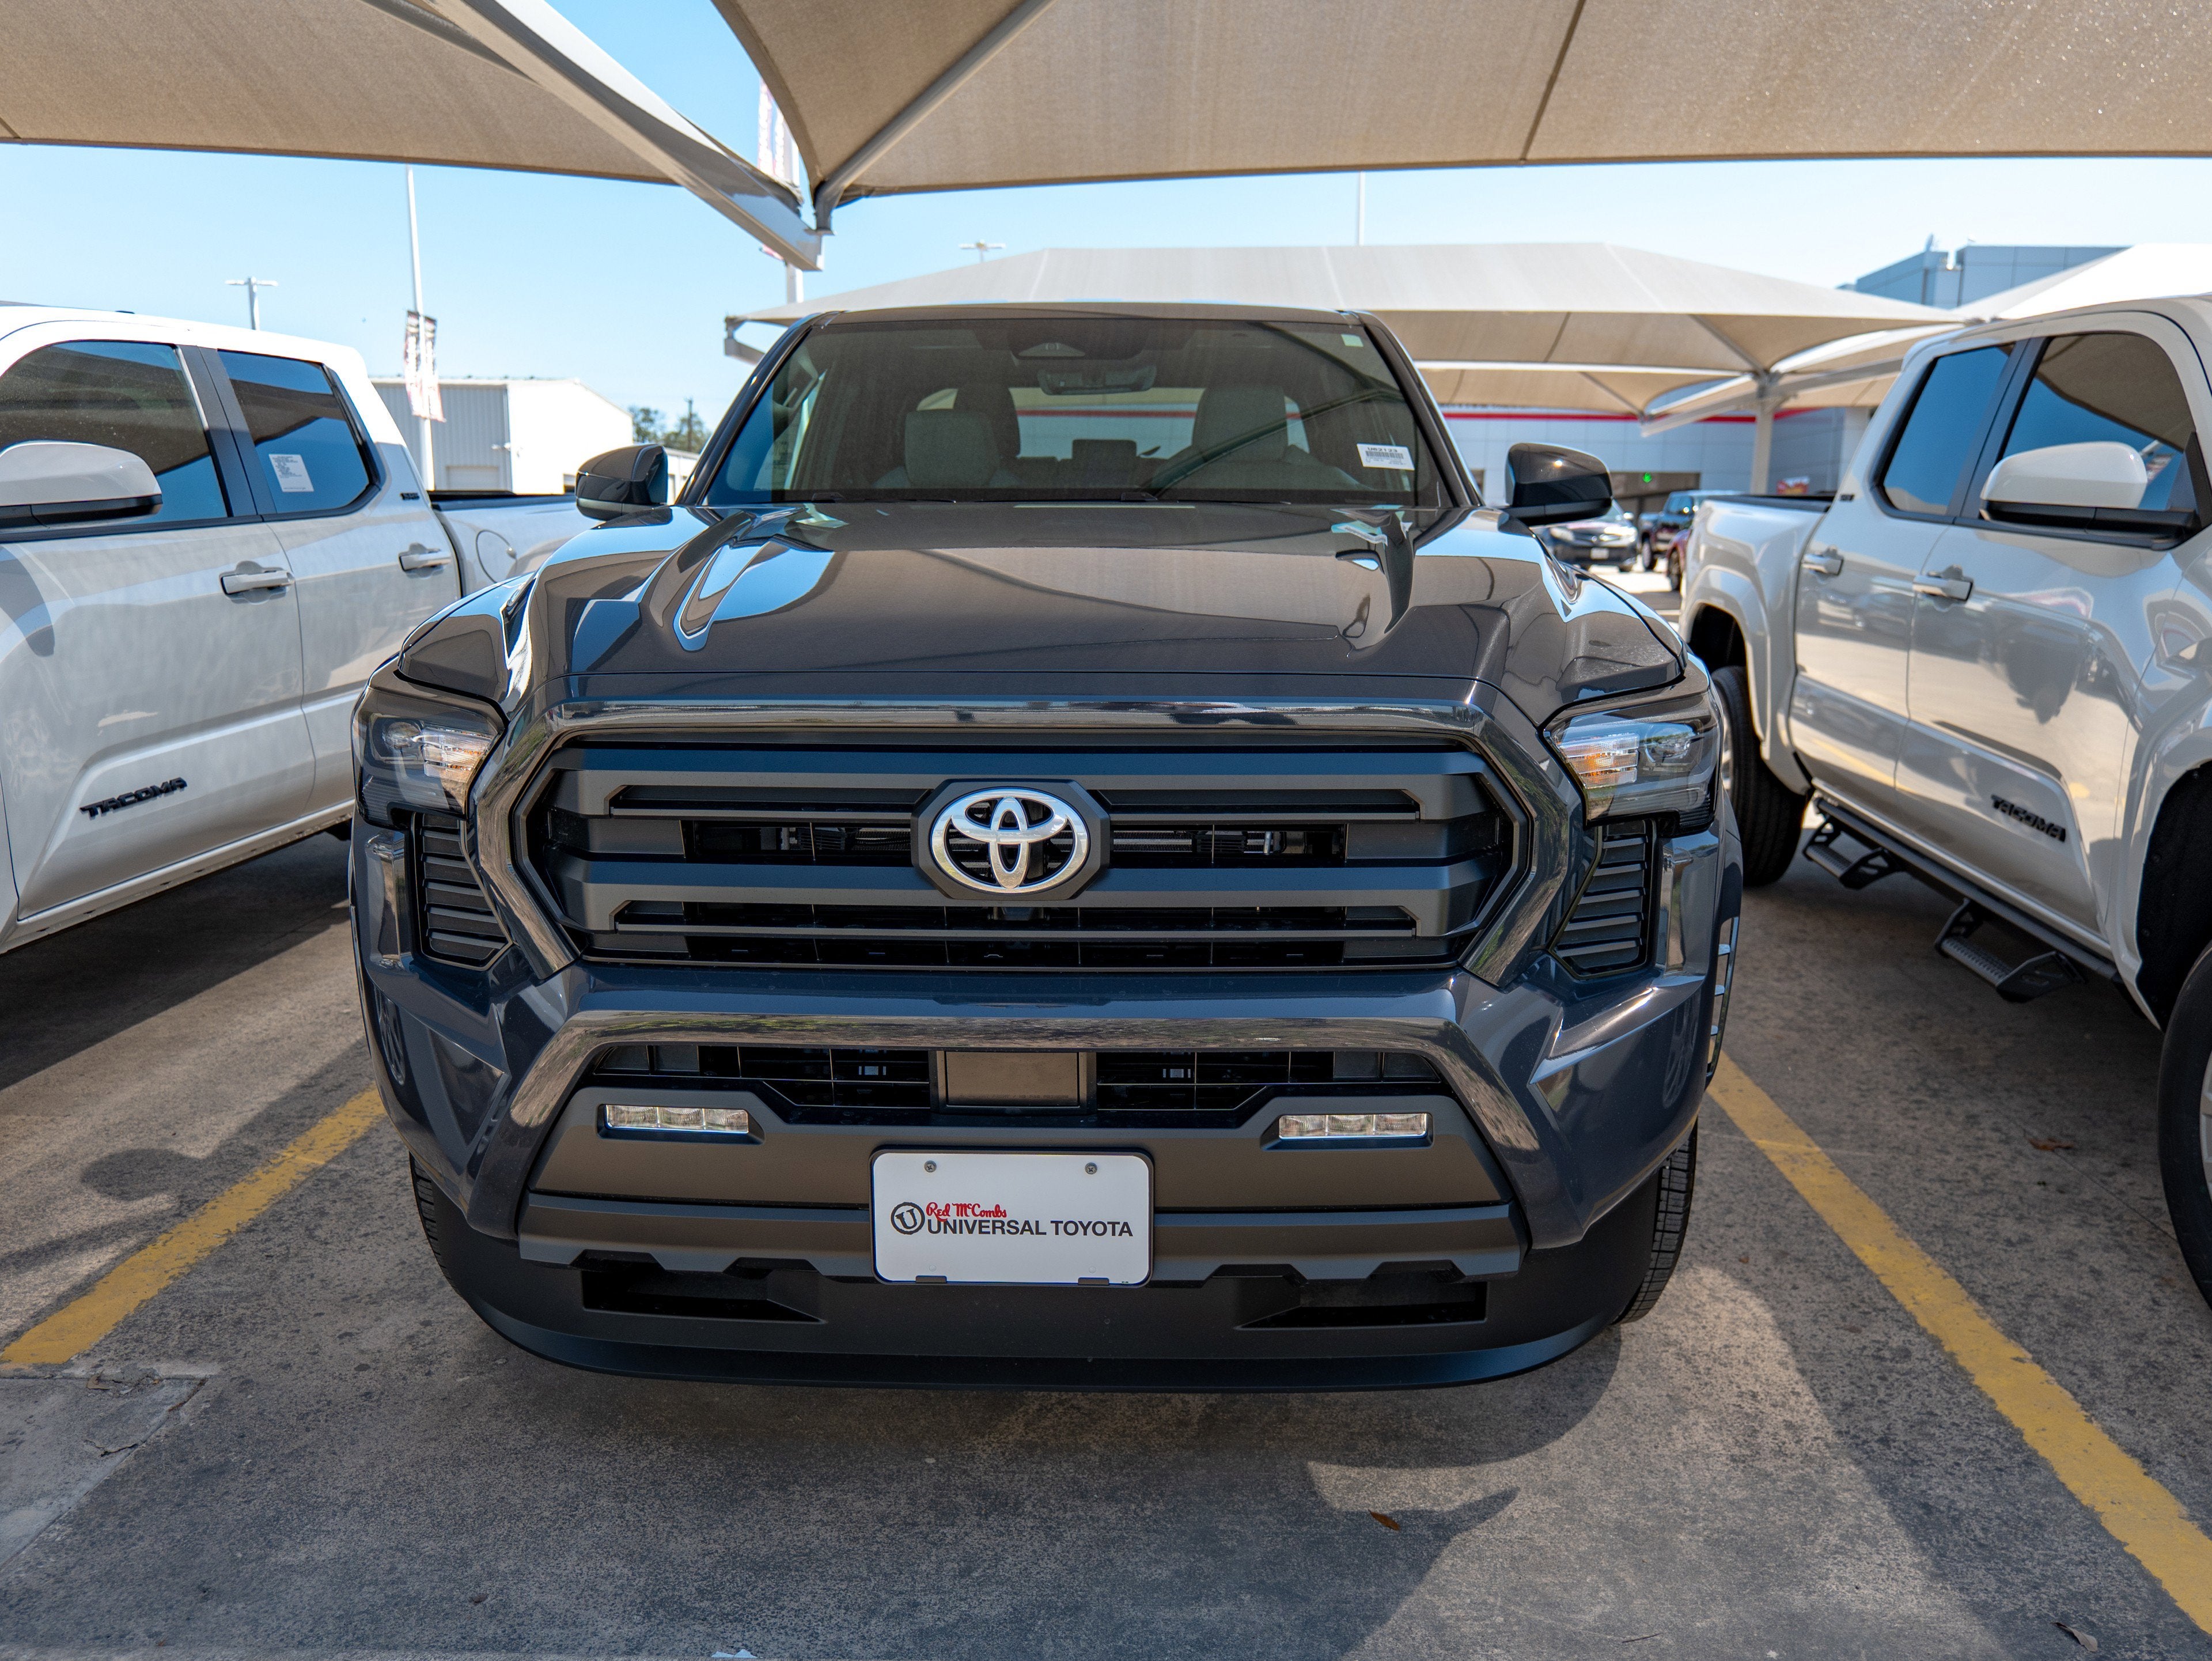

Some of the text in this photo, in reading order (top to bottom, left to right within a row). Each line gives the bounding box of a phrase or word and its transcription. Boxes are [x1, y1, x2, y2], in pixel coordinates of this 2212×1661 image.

[79, 777, 188, 819] TACOMA
[1991, 794, 2066, 843] TACOMA
[926, 1202, 950, 1222] Red
[927, 1219, 1134, 1237] UNIVERSAL TOYOTA
